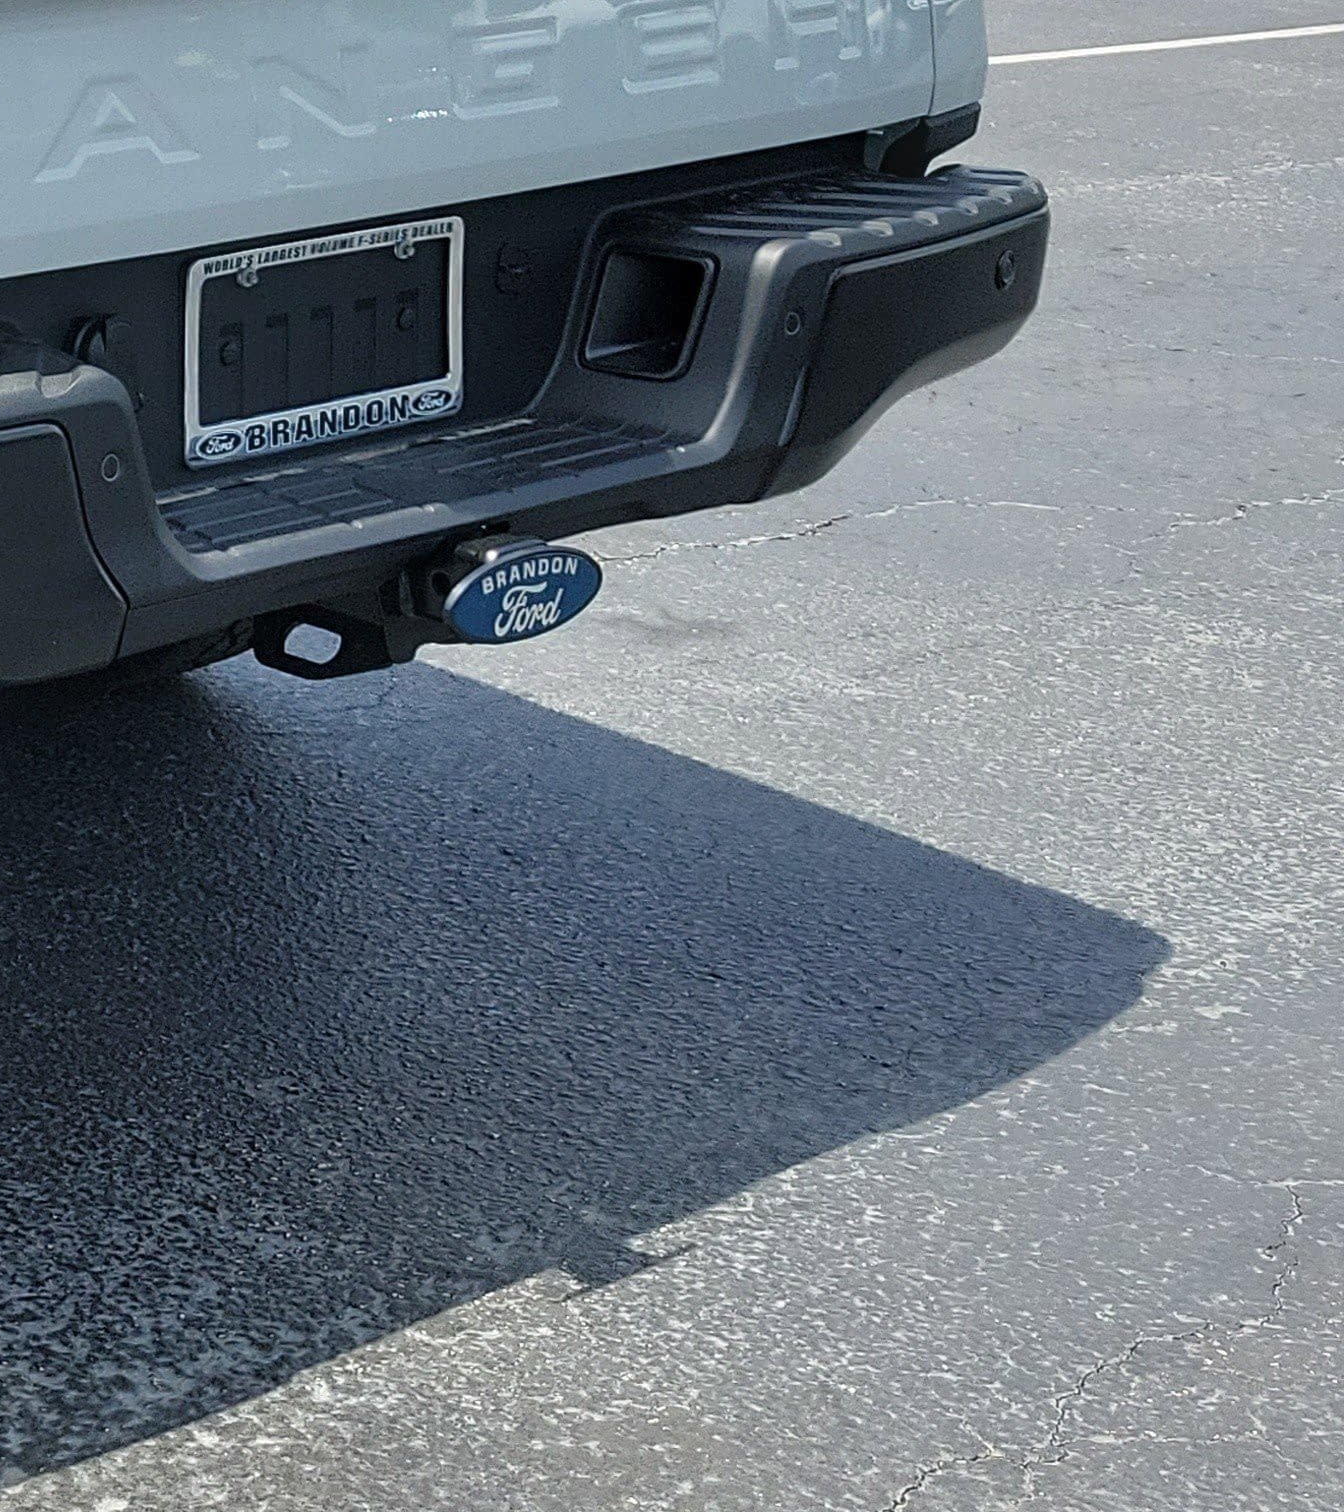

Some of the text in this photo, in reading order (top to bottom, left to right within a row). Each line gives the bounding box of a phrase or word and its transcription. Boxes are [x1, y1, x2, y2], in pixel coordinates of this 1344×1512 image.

[203, 222, 454, 275] WORLD'S LARGEST VOLUME F-SERIES DEALER
[205, 392, 446, 453] Ford BRANDON Ford
[481, 556, 578, 594] BRANDON
[494, 581, 564, 637] Ford
